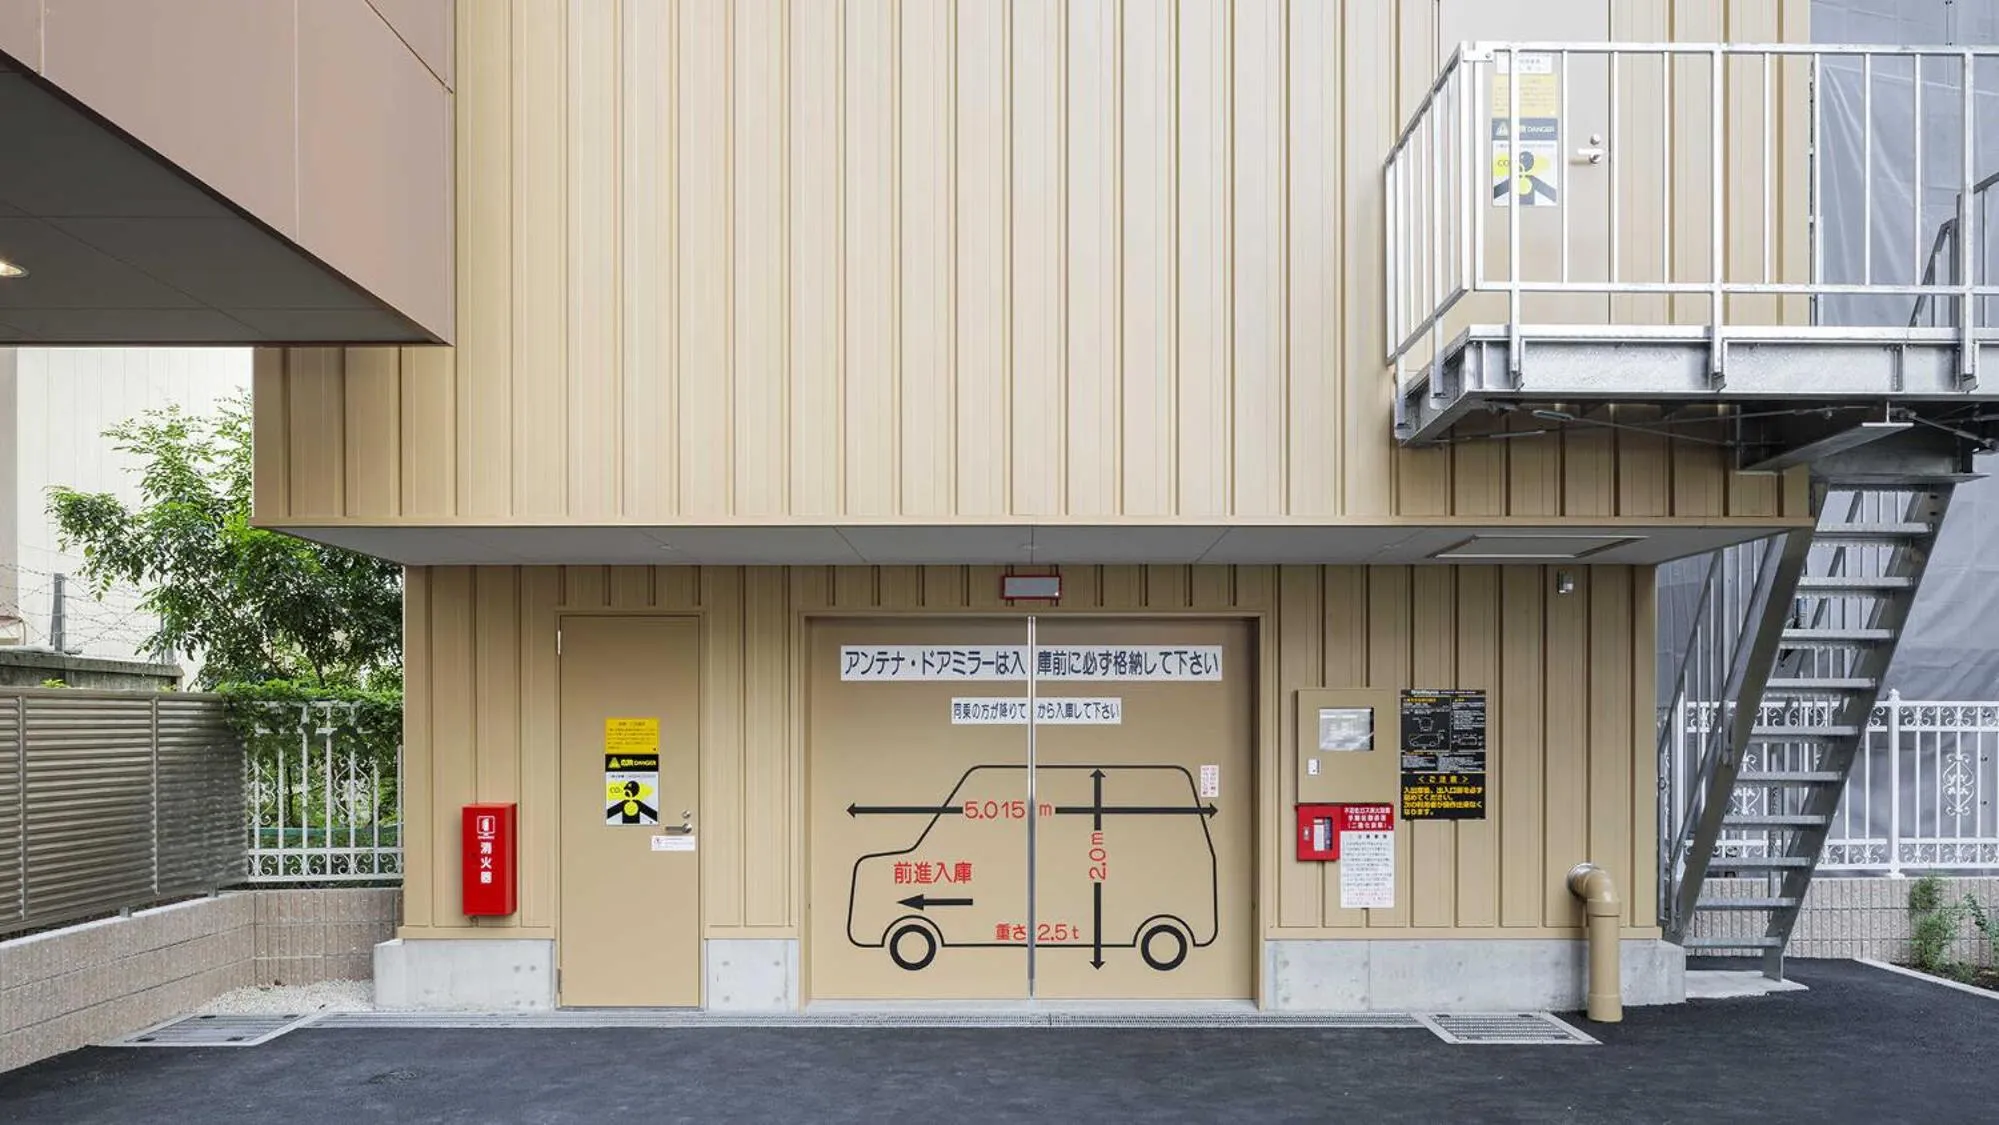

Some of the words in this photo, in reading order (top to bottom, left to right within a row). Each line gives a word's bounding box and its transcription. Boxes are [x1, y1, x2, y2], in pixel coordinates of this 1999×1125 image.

[964, 800, 1026, 819] 5.015
[893, 861, 973, 884] 前進入庫
[995, 923, 1027, 941] 重さ
